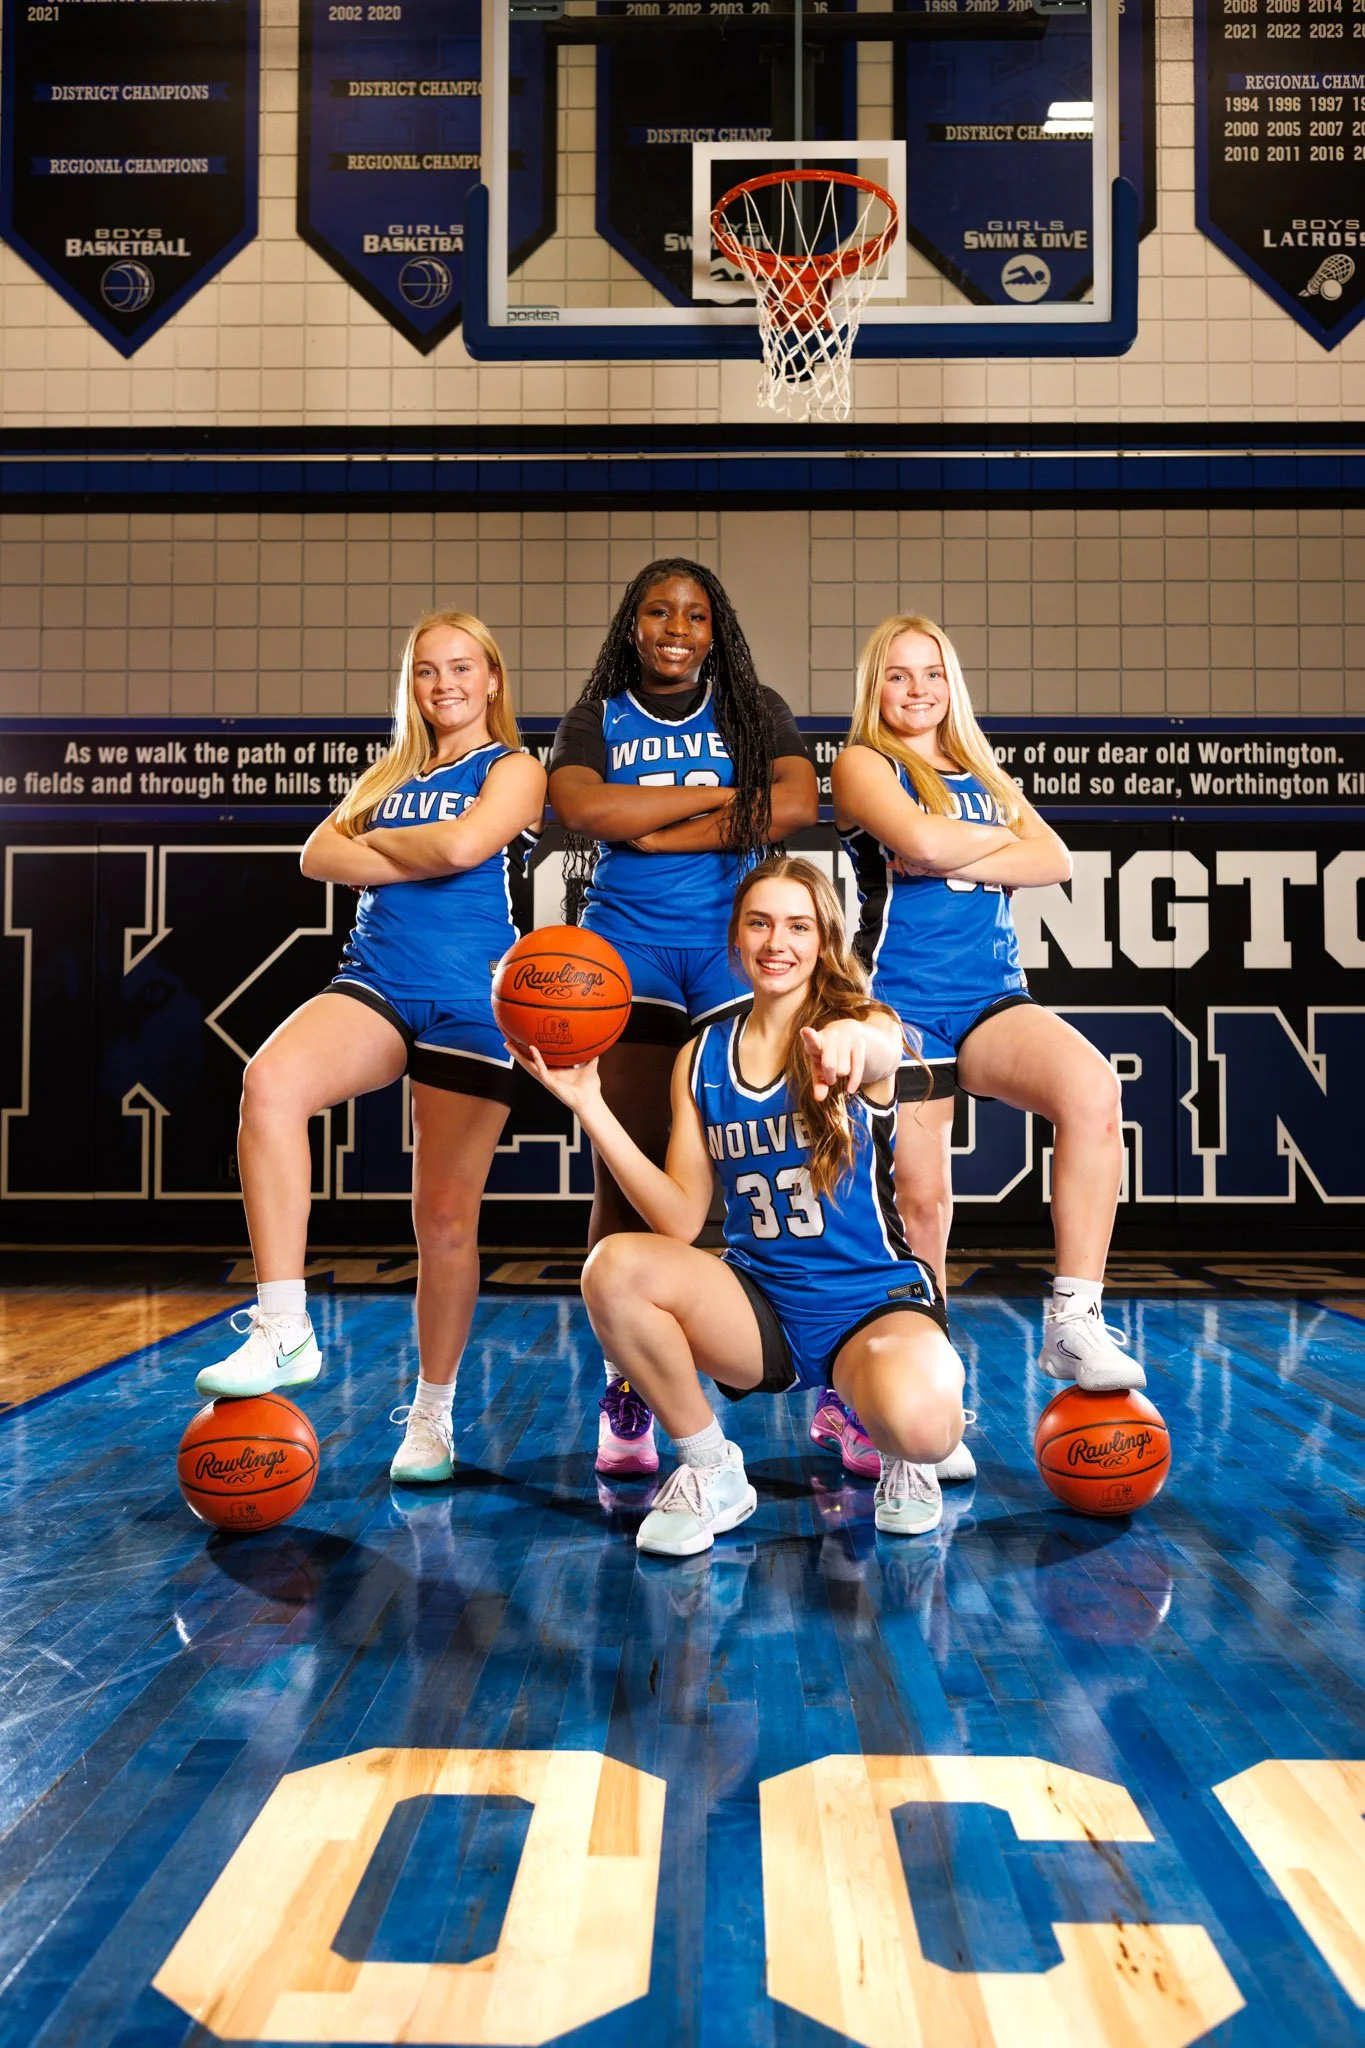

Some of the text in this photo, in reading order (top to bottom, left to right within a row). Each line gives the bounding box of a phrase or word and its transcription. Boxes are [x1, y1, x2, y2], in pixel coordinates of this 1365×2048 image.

[329, 6, 401, 20] 2002 2020
[1008, 0, 1033, 12] 200
[1224, 0, 1257, 13] 2008
[1266, 0, 1300, 13] 2009
[1308, 0, 1343, 13] 2014
[28, 6, 59, 22] 2021
[1224, 24, 1257, 38] 2021
[1267, 24, 1301, 38] 2022
[1309, 24, 1344, 38] 2023
[349, 81, 417, 96] DISTRICT
[1245, 75, 1319, 89] REGIONAL
[51, 85, 209, 100] DISTRICT CHAMPIONS
[1225, 97, 1259, 112] 1994
[1267, 97, 1301, 112] 1996
[1310, 97, 1343, 112] 1997
[647, 128, 772, 143] DISTRICT CHAMP
[945, 126, 1093, 140] DISTRICT CHAMPIO
[1224, 122, 1259, 137] 2000
[1267, 122, 1301, 137] 2005
[1309, 122, 1344, 136] 2007
[1224, 146, 1259, 161] 2010
[1267, 146, 1300, 161] 2011
[1310, 146, 1344, 161] 2016
[50, 159, 208, 174] REGIONAL CHAMPIONS
[348, 155, 420, 170] REGIONAL
[388, 224, 464, 235] GIRLS
[987, 220, 1064, 231] GIRLS
[1292, 219, 1360, 230] BOYS
[95, 228, 162, 239] BOYS
[964, 230, 1088, 249] SWIM & DIVE
[65, 238, 191, 257] BASKETBALL
[64, 742, 92, 764] As
[98, 746, 128, 764] we
[135, 742, 188, 764] walk
[194, 742, 229, 764] the
[237, 742, 286, 768] path
[294, 742, 317, 764] of
[323, 742, 359, 764] life
[1024, 741, 1046, 764] of
[1053, 746, 1090, 764] our
[1098, 741, 1148, 764] dear
[1156, 742, 1190, 764] old
[1198, 741, 1345, 769] Worthington.
[611, 732, 730, 771] WOLVE
[24, 772, 85, 794] fields
[91, 772, 132, 794] and
[140, 772, 225, 799] through
[232, 772, 268, 794] the
[275, 772, 321, 794] hills
[1033, 772, 1080, 795] hold
[1089, 776, 1115, 795] so
[1124, 772, 1182, 799] dear,
[1190, 772, 1329, 800] Worthington
[513, 962, 606, 997] Rawlings
[706, 1112, 813, 1161] WOLVE
[735, 1166, 826, 1240] 33
[1067, 1430, 1153, 1467] Rawlings
[195, 1446, 288, 1480] Rawlings
